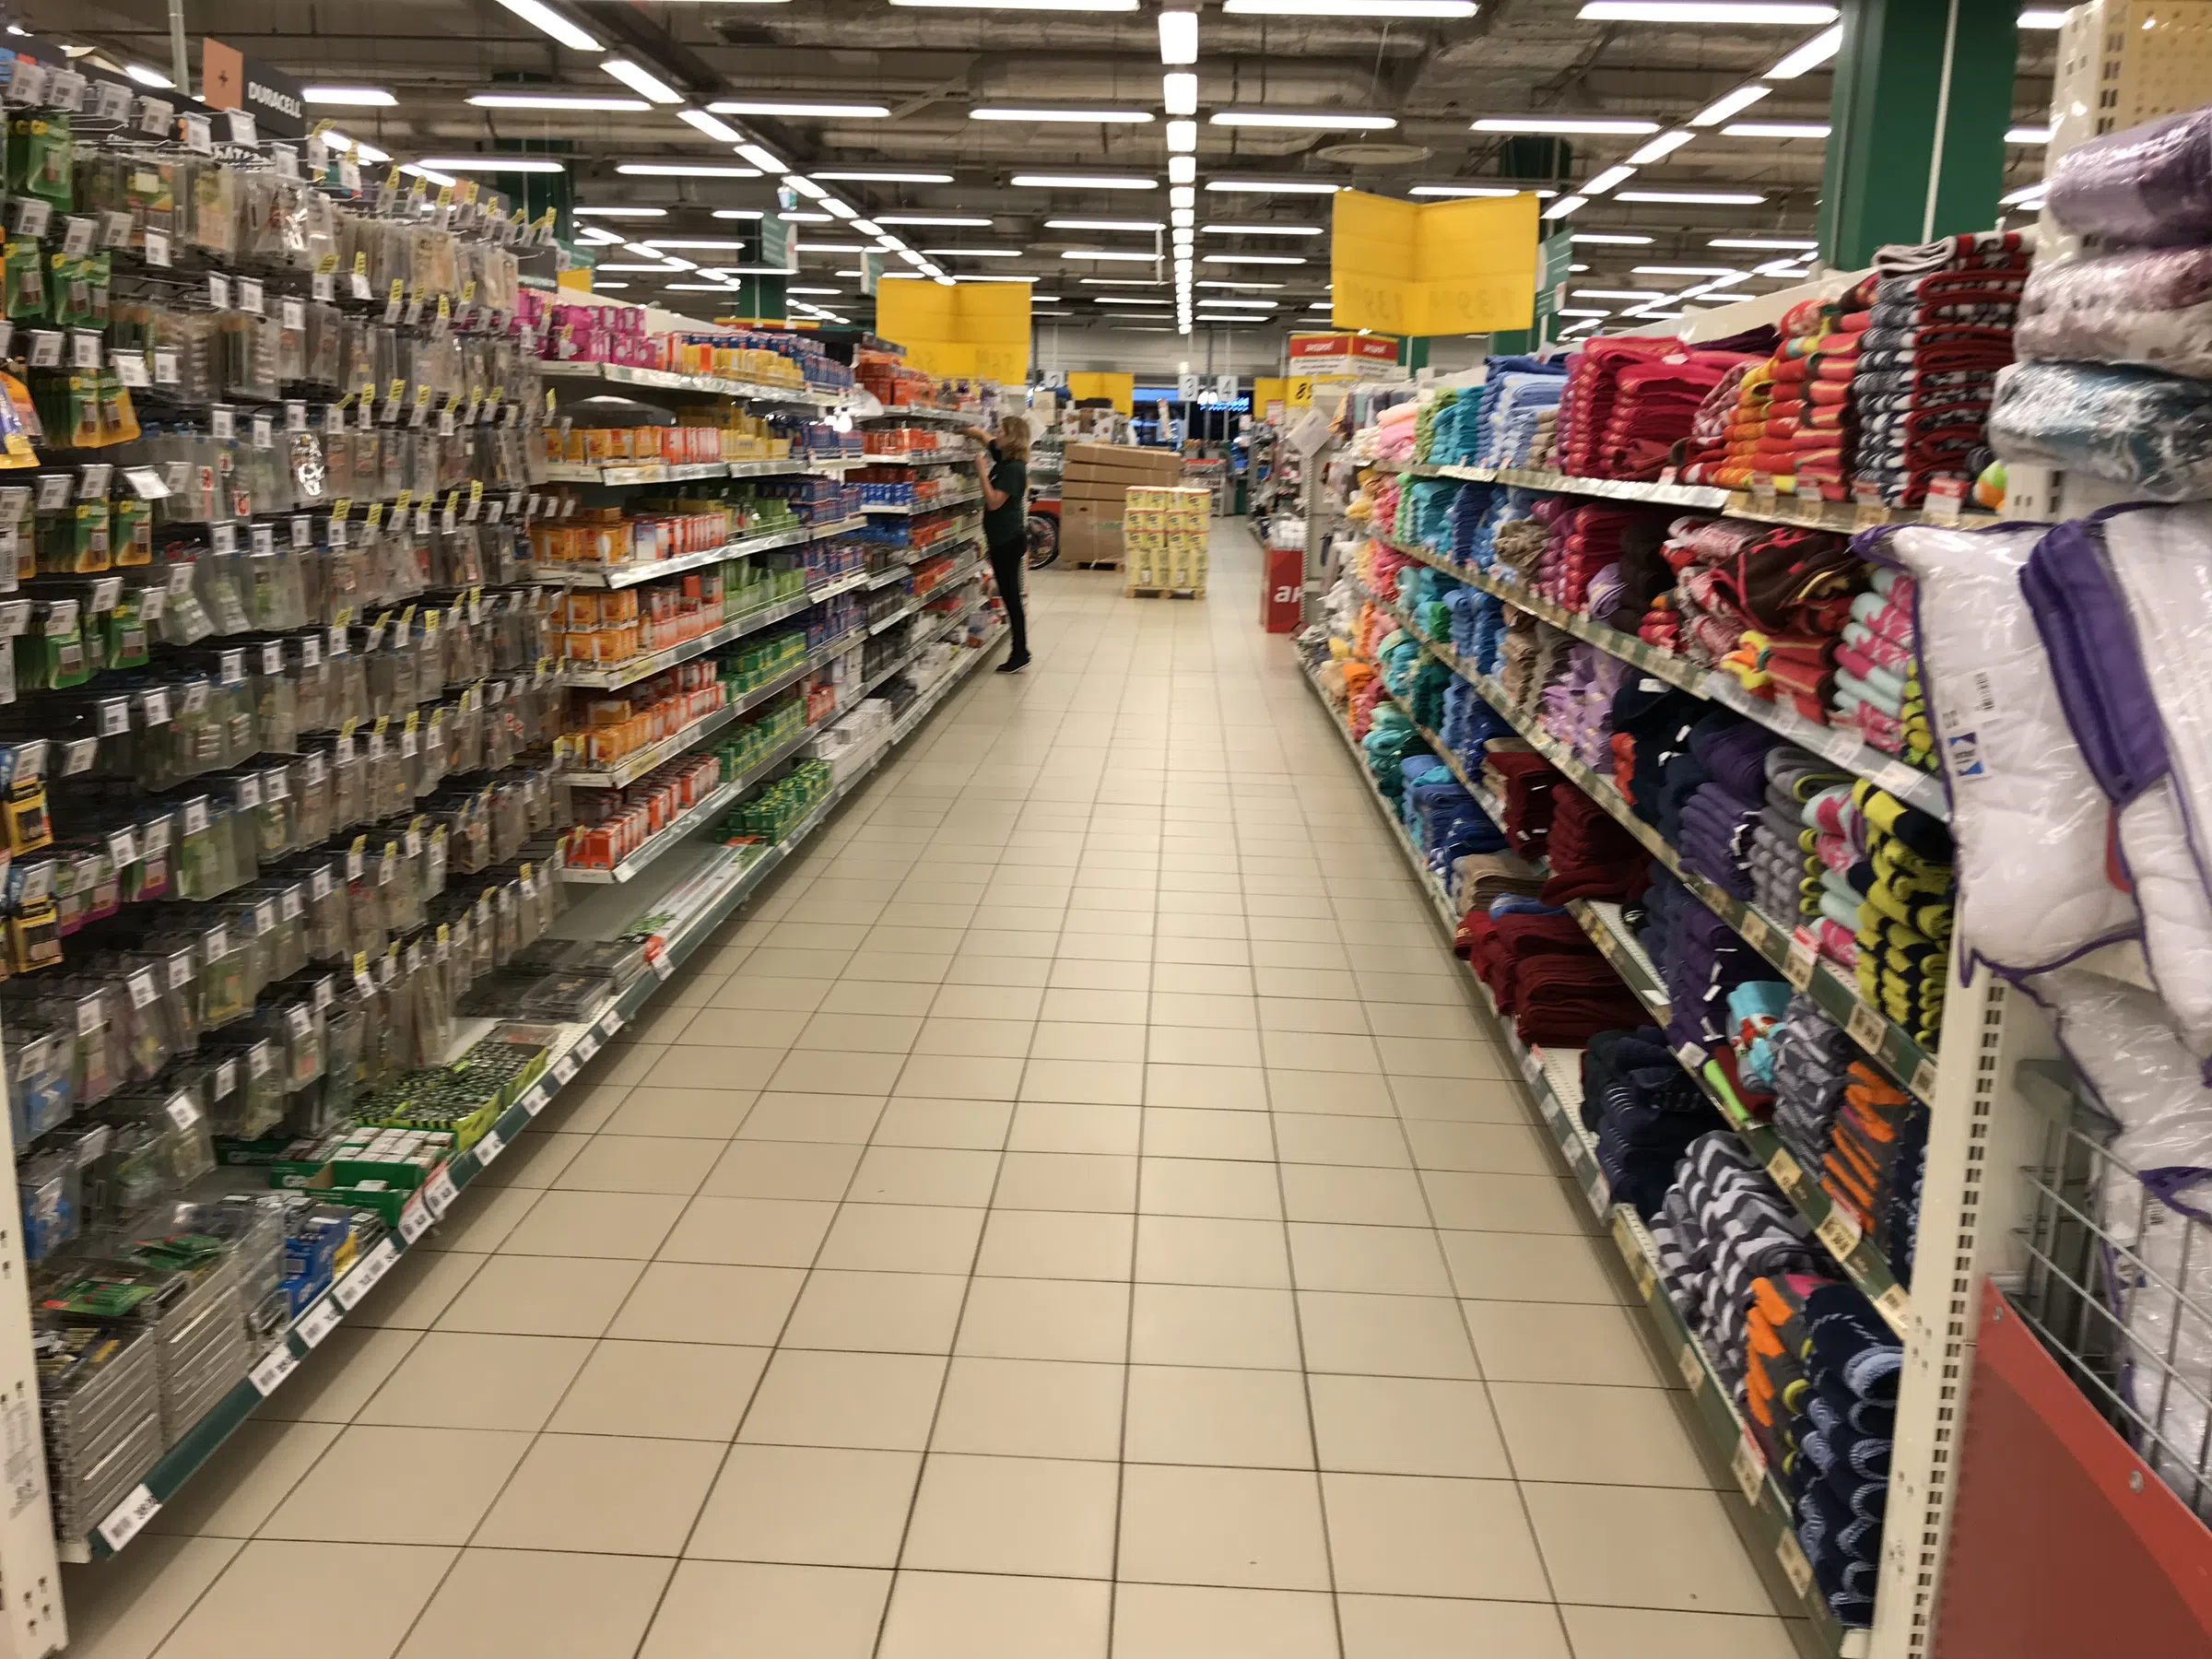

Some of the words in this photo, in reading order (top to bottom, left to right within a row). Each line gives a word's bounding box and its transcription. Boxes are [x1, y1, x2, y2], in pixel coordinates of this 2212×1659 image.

[248, 81, 302, 119] DURACELL
[1184, 378, 1194, 397] 3
[1222, 378, 1233, 395] 4
